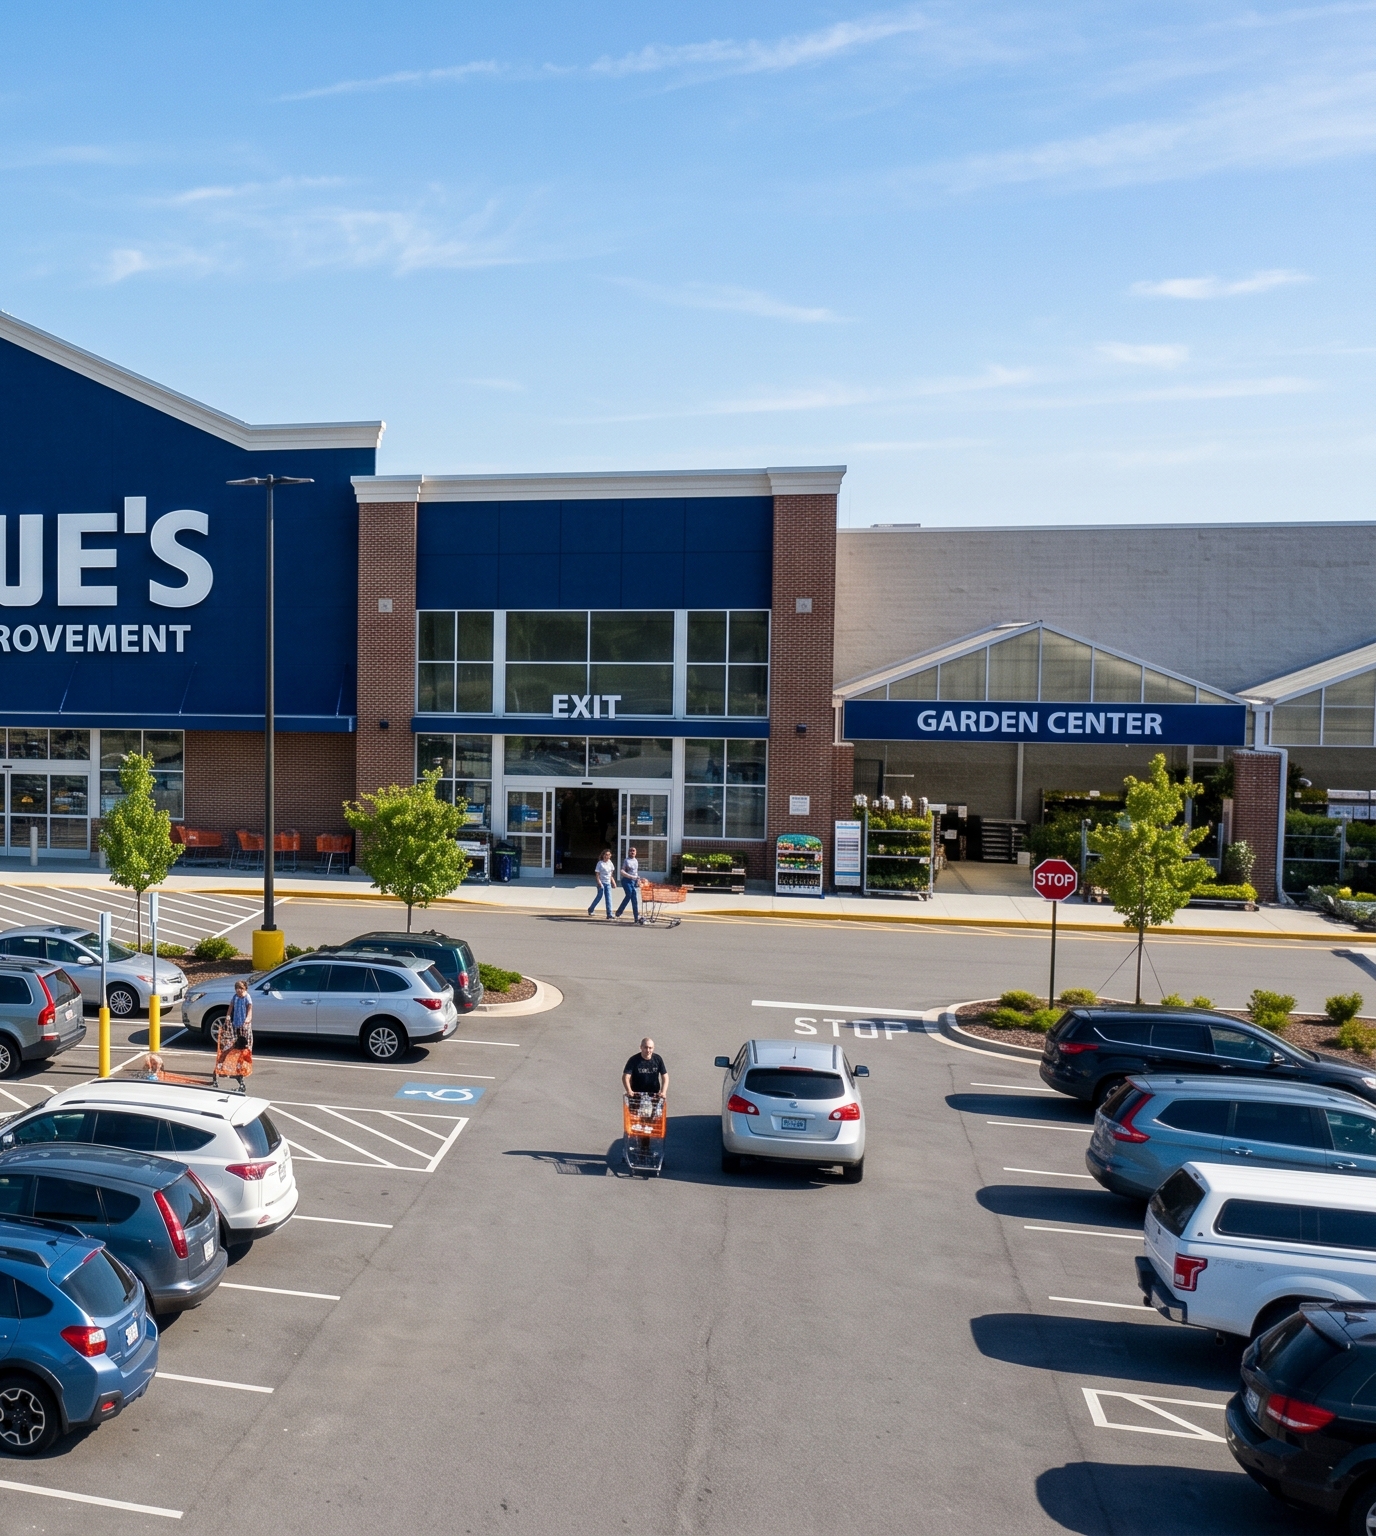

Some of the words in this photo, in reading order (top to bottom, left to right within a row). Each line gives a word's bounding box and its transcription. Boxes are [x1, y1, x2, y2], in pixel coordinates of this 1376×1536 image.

[552, 694, 622, 719] EXIT
[916, 710, 1039, 733] GARDEN
[1047, 711, 1163, 735] CENTER
[1036, 872, 1075, 887] STOP
[794, 1017, 909, 1040] STOP
